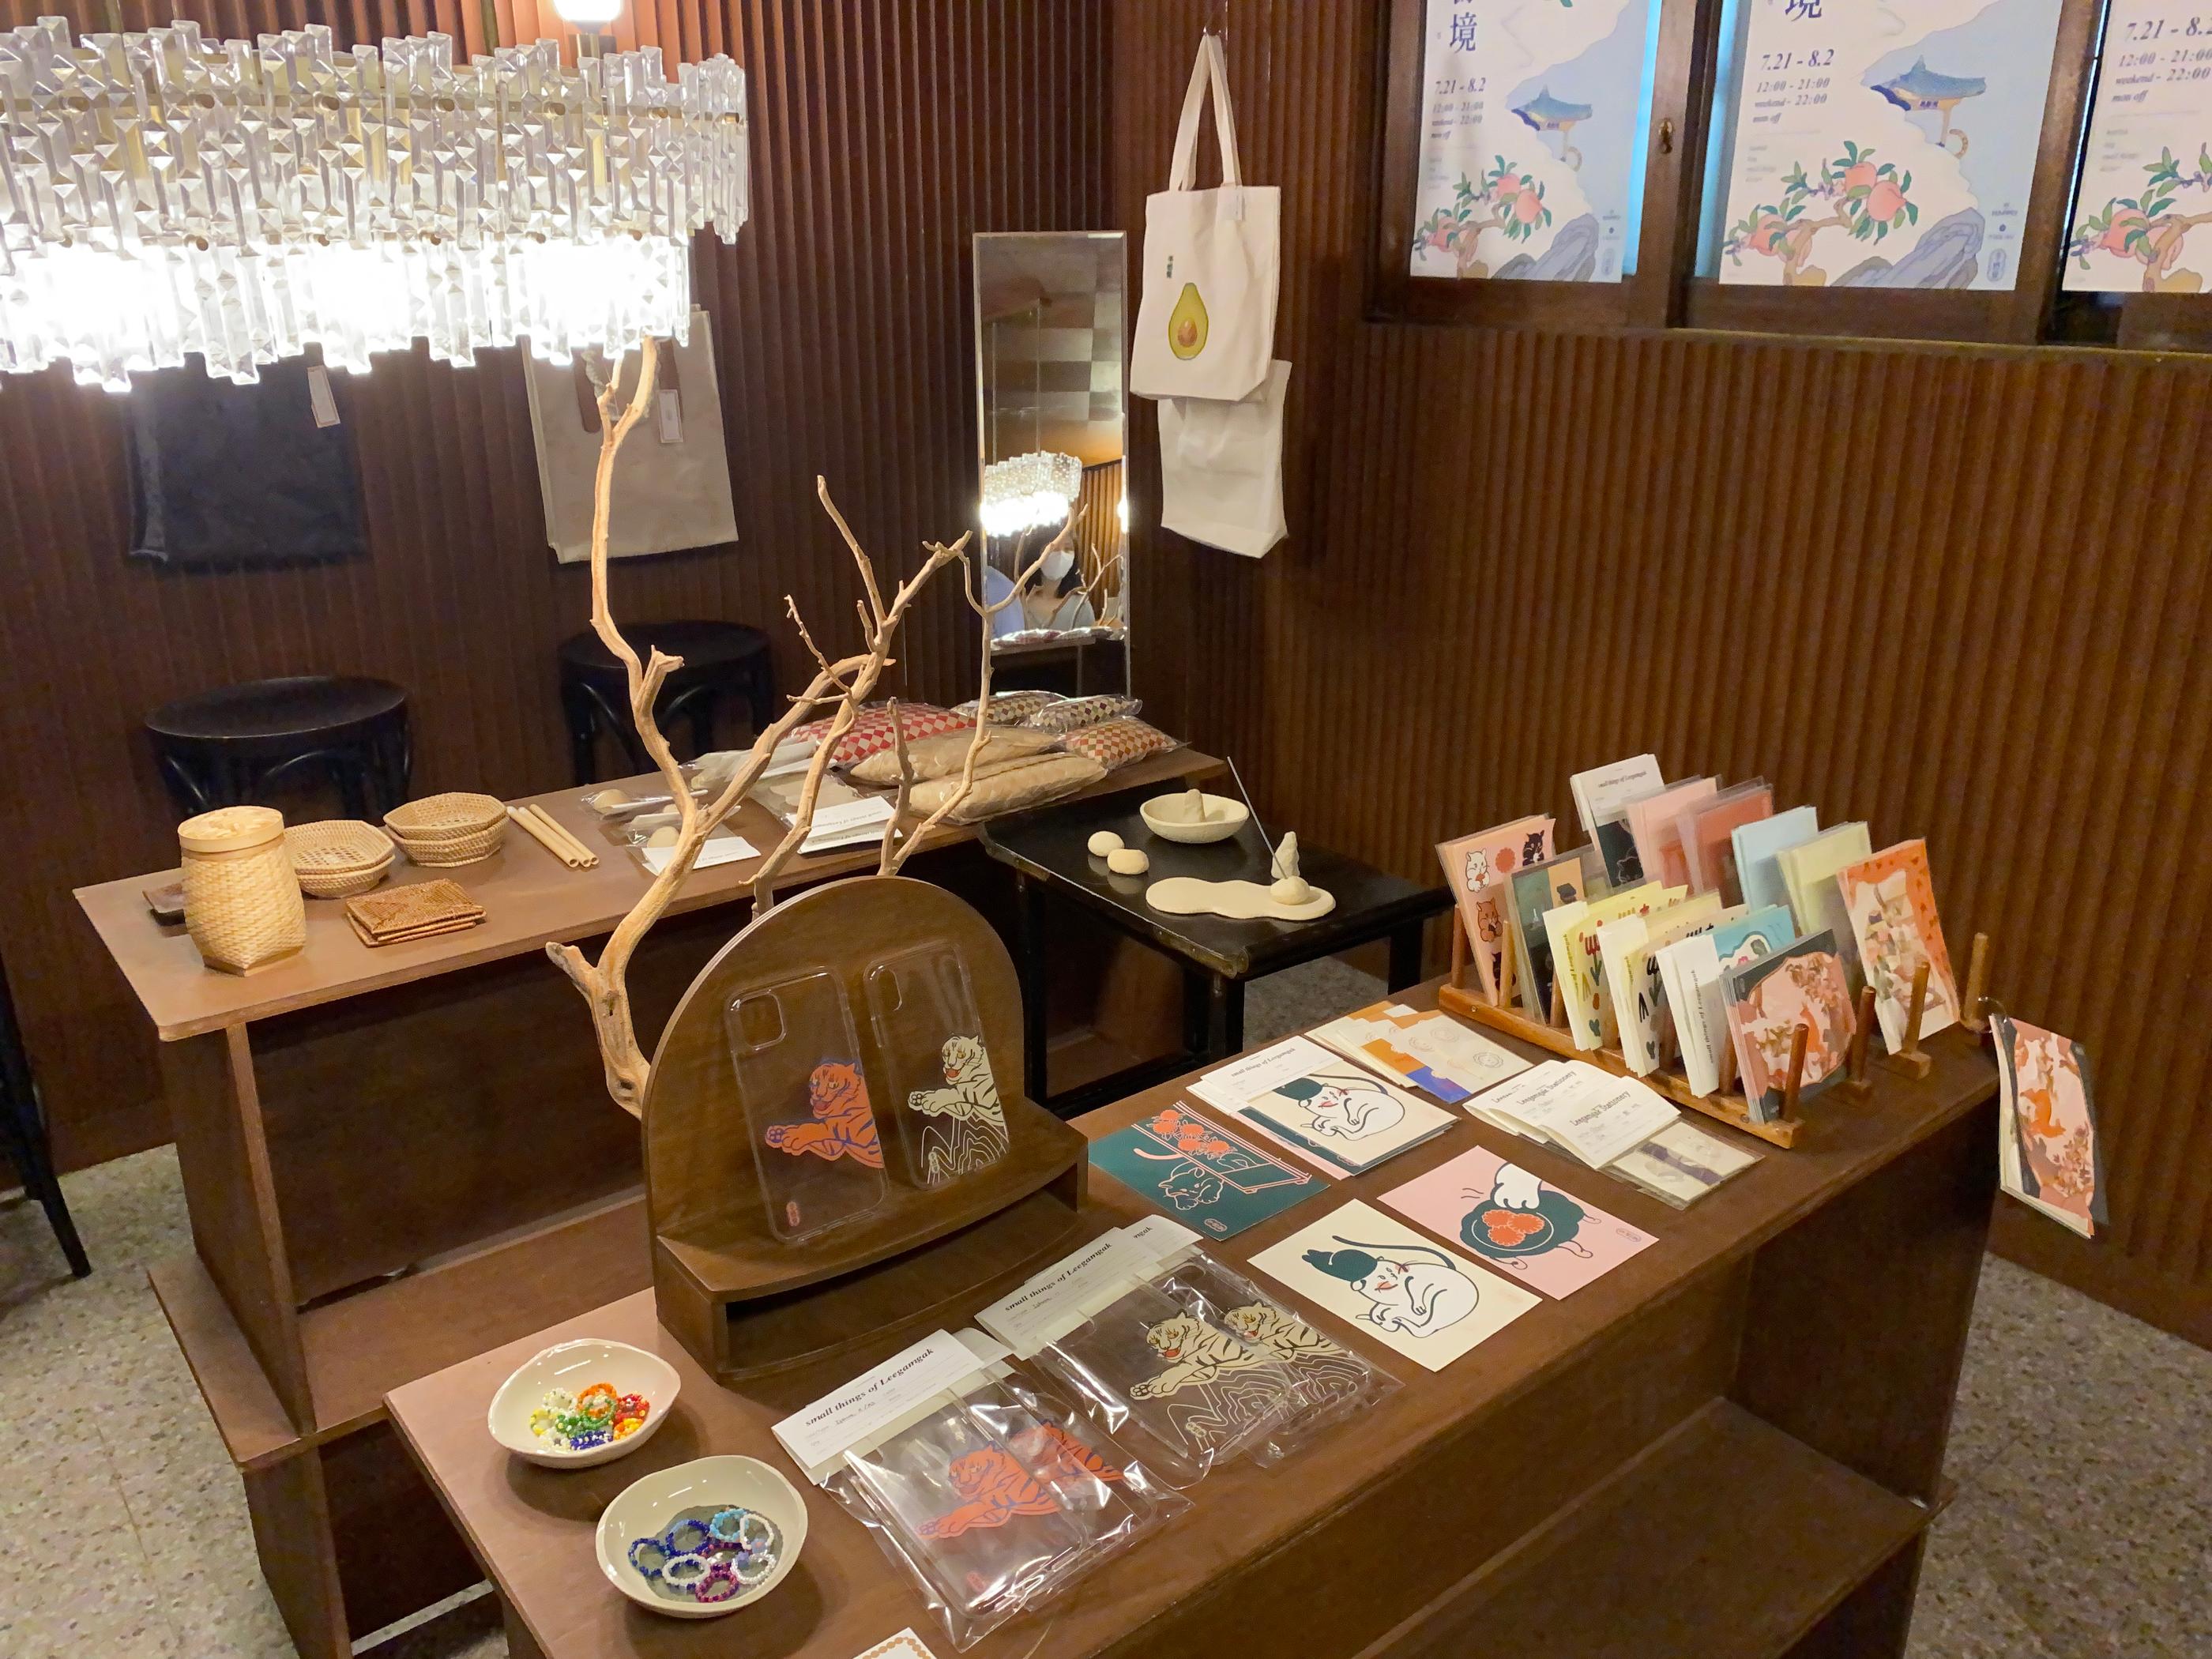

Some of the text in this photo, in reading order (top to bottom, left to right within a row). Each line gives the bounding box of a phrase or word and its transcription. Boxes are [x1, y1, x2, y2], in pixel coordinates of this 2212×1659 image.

[1450, 0, 1477, 54] 境
[2125, 19, 2165, 41] 7.21
[1760, 52, 1793, 70] 7.21
[1808, 48, 1834, 67] 8.2
[2119, 52, 2156, 67] 12:00
[2171, 48, 2212, 63] 21:00
[1756, 81, 1787, 93] 12:00
[1797, 77, 1830, 90] 21:00
[2116, 73, 2154, 85] weekend
[2167, 67, 2211, 81] 22:00
[1435, 79, 1457, 95] 7.21
[1467, 77, 1486, 92] 8.2
[1795, 93, 1827, 106] 22:00
[2133, 89, 2149, 103] off
[1005, 1295, 1028, 1311] small
[1029, 1281, 1056, 1297] things
[1057, 1273, 1066, 1283] of
[1066, 1243, 1112, 1276] Leegamgak
[806, 1407, 833, 1426] small
[835, 1392, 866, 1411] things
[868, 1383, 878, 1394] of
[880, 1349, 934, 1386] Leegamgak
